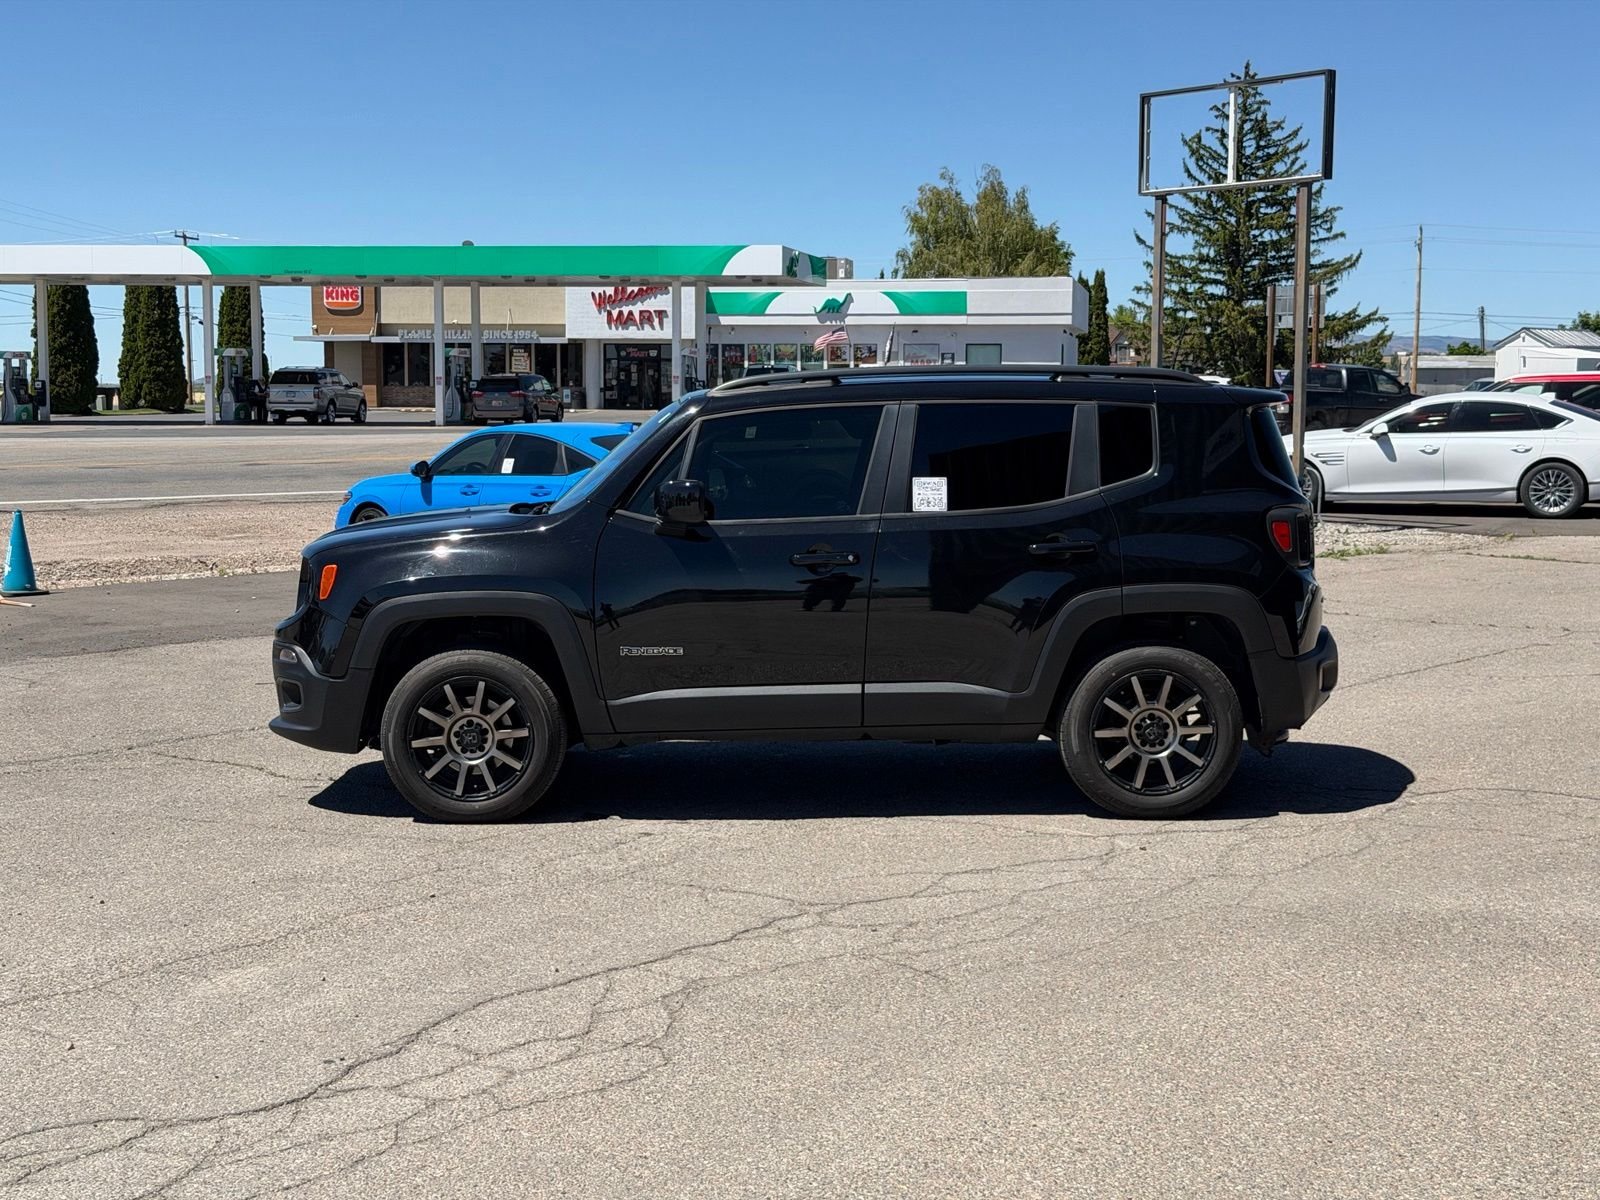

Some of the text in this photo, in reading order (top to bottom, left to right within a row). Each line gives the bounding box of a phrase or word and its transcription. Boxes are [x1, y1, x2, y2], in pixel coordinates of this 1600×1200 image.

[325, 289, 360, 301] KING
[606, 309, 669, 330] MART
[398, 329, 432, 339] FLAME
[482, 329, 513, 339] SINCE
[513, 329, 539, 339] 1954
[620, 646, 684, 656] RENEGADE
